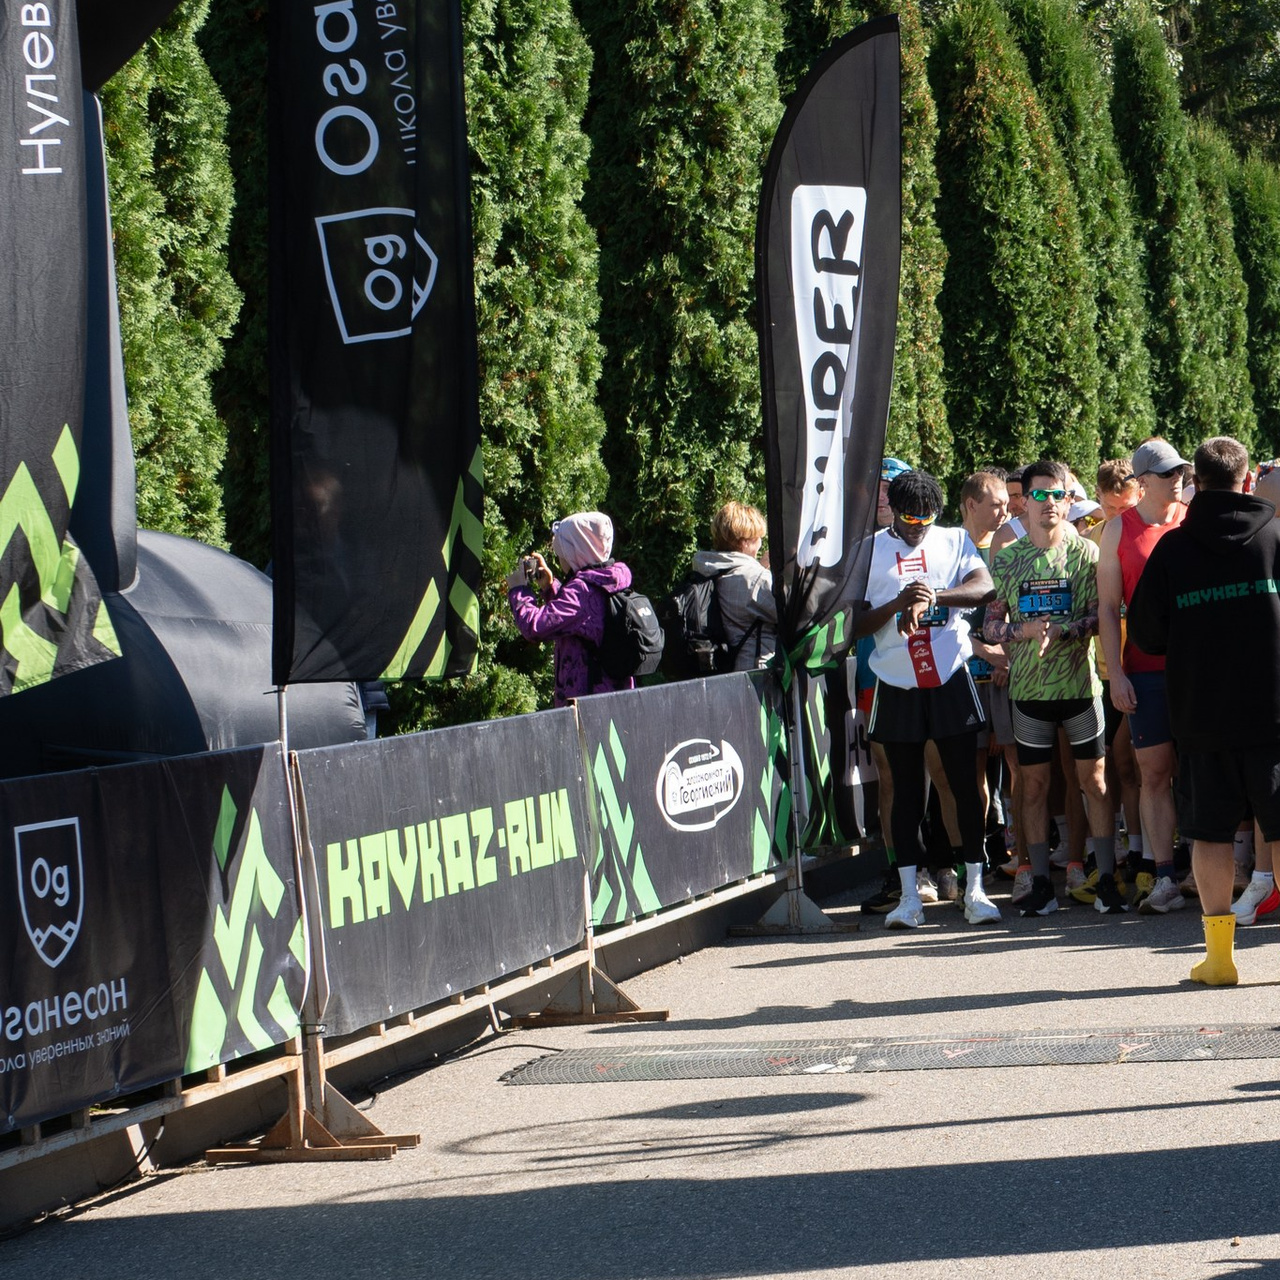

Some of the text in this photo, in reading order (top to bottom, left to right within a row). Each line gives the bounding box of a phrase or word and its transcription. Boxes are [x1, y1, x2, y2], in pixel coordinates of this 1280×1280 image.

[1028, 594, 1063, 608] 1135
[0, 977, 127, 1041] ганесон
[28, 1034, 95, 1071] уверенных
[96, 1018, 131, 1048] знаний
